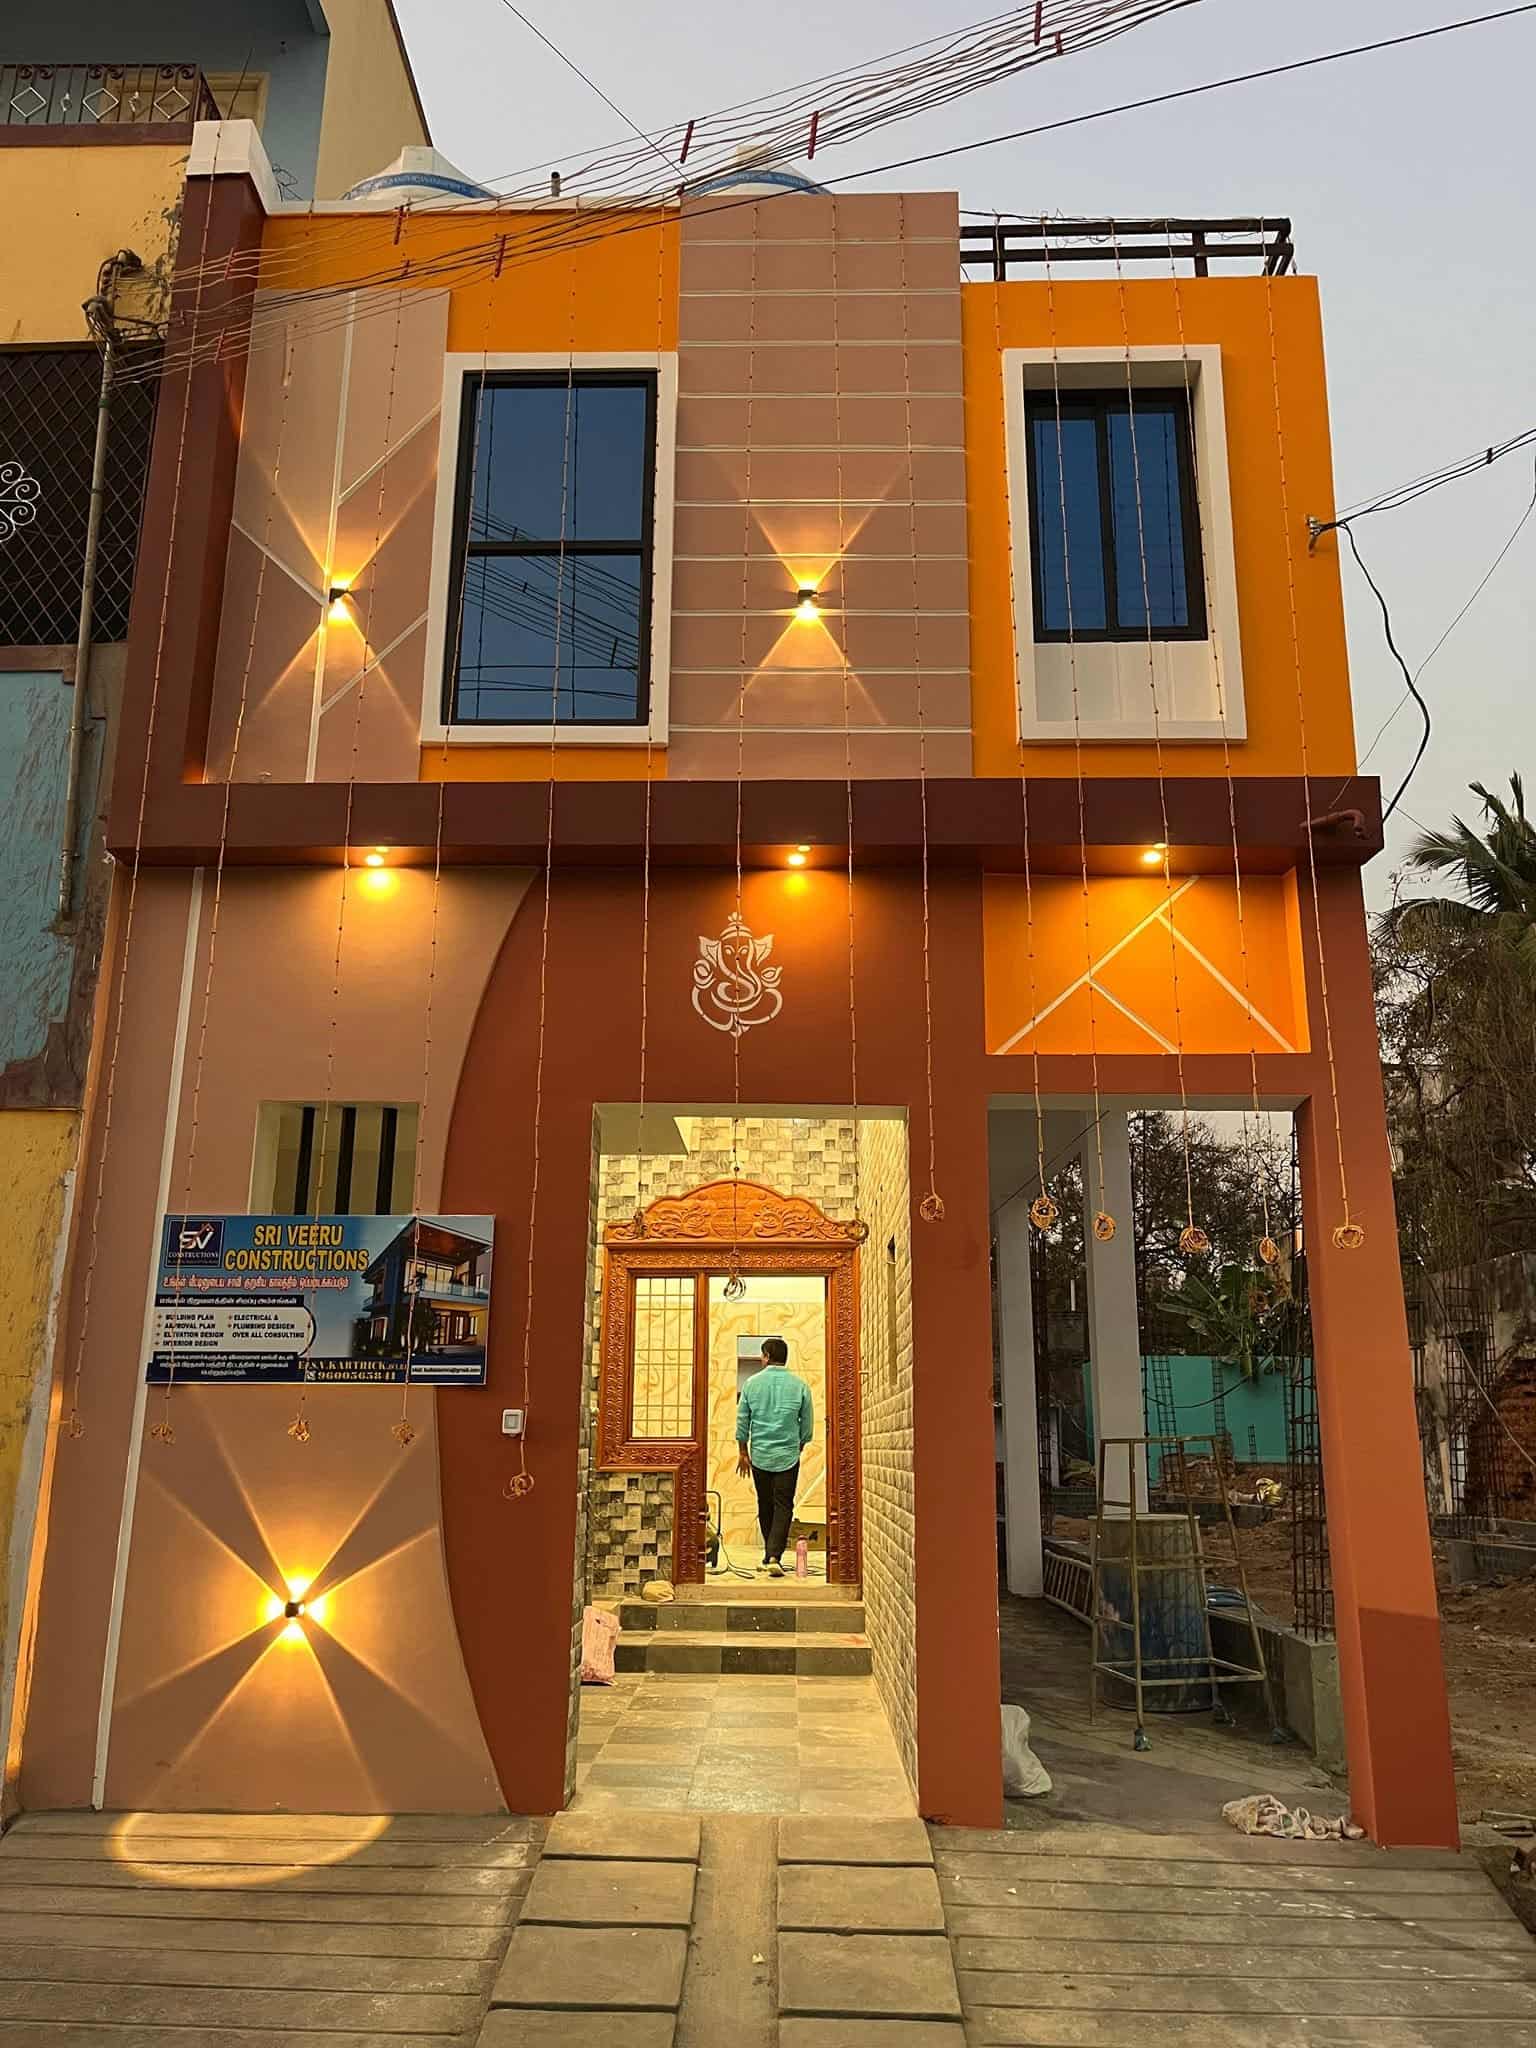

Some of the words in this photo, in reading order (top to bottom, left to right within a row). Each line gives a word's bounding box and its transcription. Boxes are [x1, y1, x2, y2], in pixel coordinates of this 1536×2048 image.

[254, 1224, 281, 1246] SRI
[287, 1223, 343, 1246] VEERU
[224, 1249, 369, 1272] CONSTRUCTIONS
